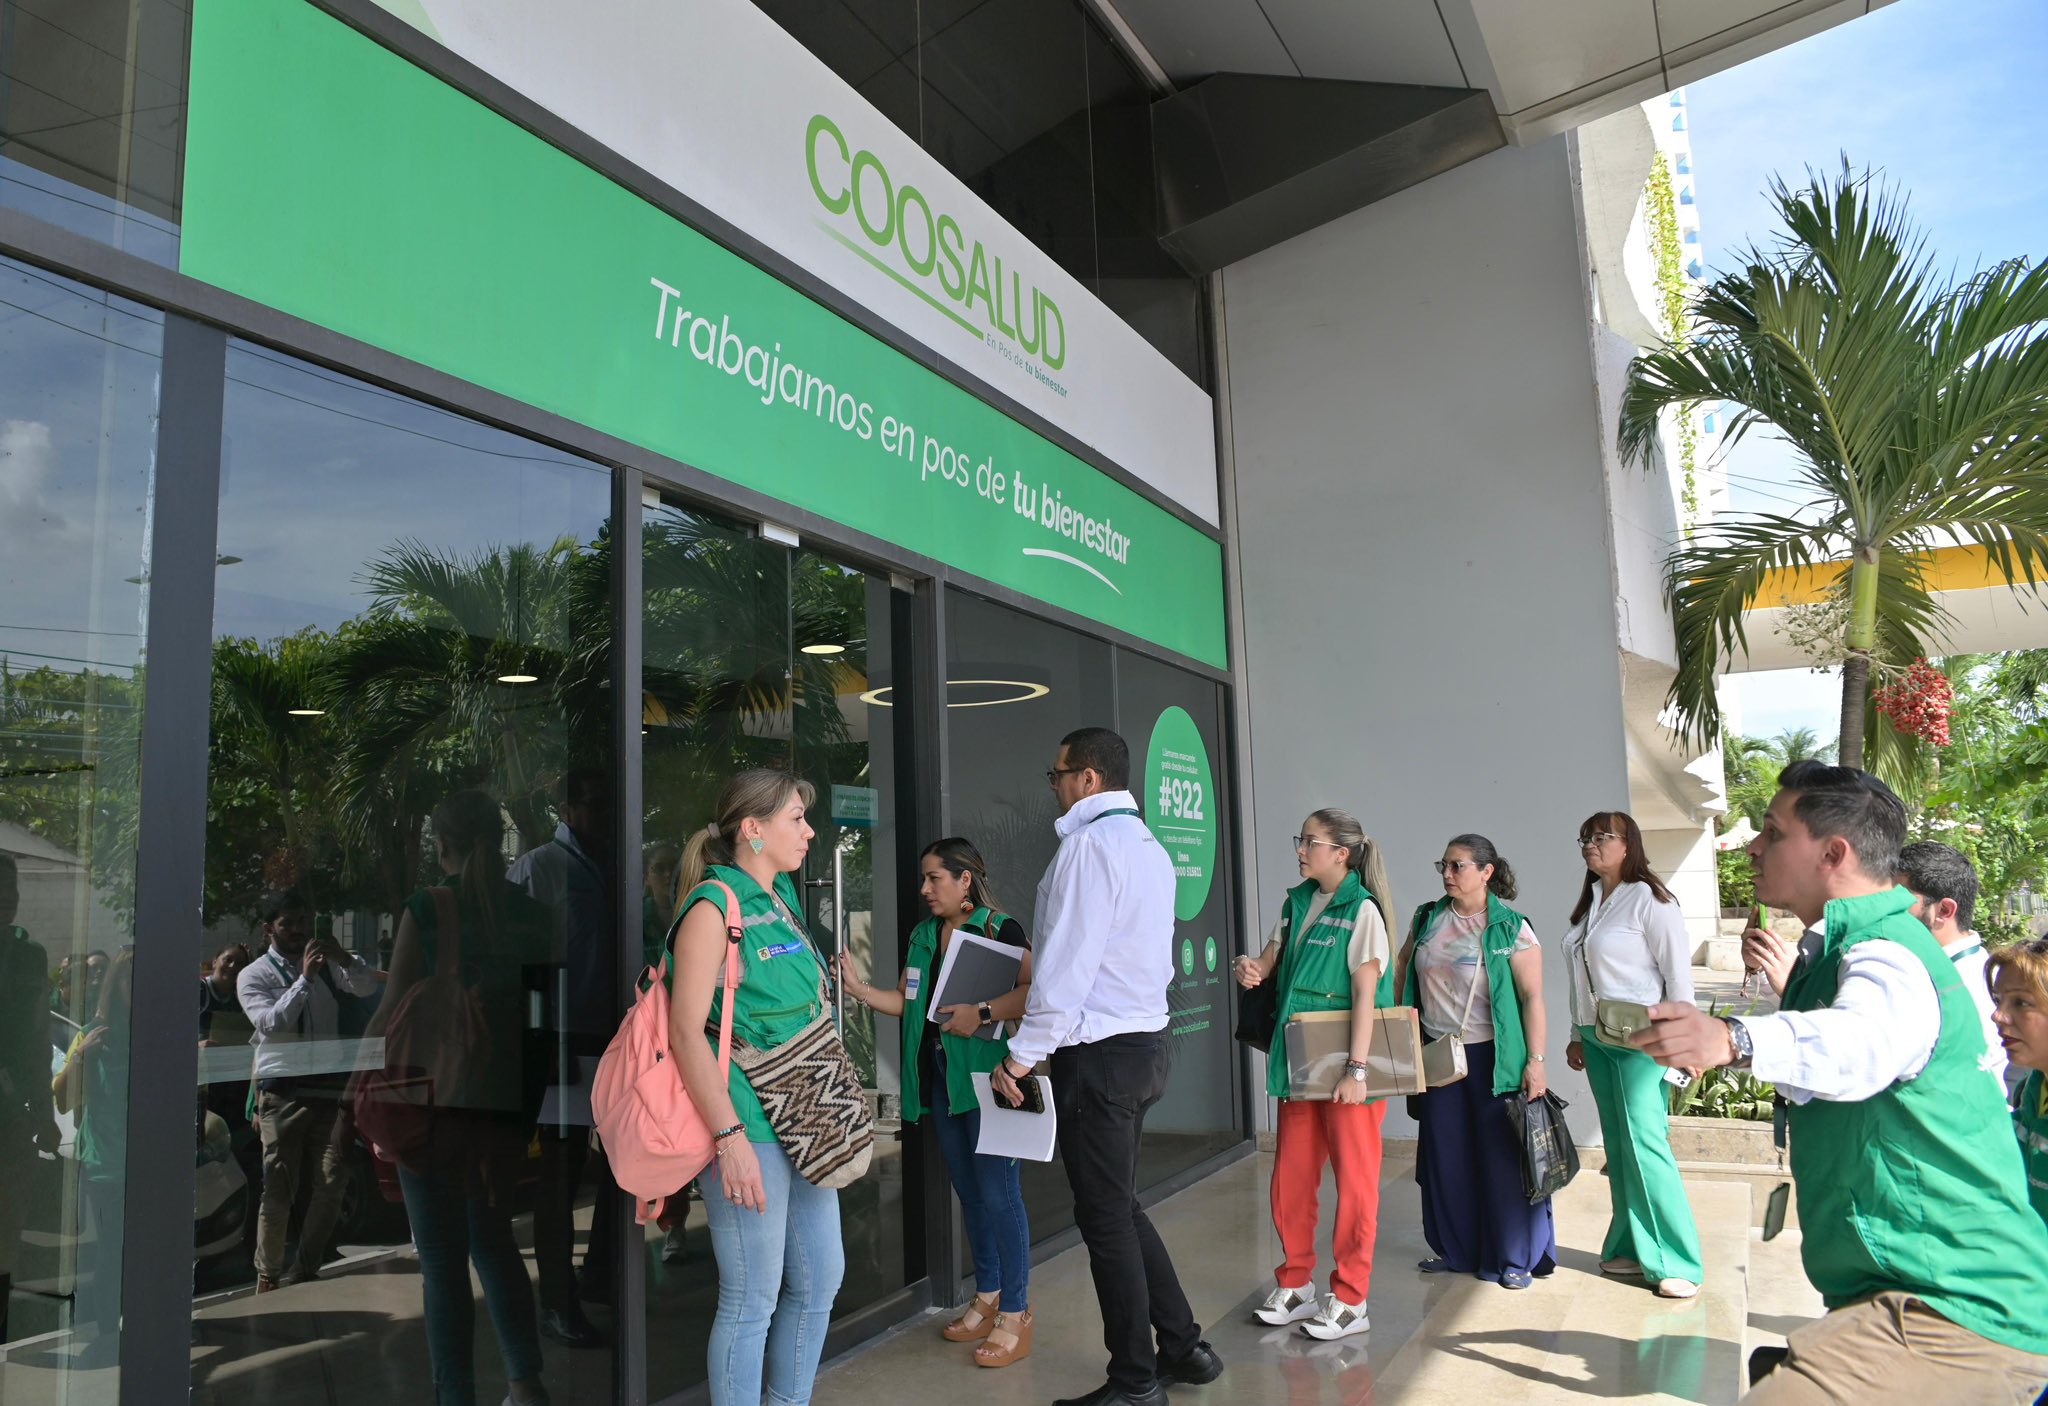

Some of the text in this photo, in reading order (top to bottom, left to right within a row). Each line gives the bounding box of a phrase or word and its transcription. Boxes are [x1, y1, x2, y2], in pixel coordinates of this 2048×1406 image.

[805, 113, 1065, 371] COOSALUD
[650, 277, 1131, 566] Trabajamos en pos de tu bienestar
[986, 333, 996, 350] En
[1014, 352, 1023, 368] de
[1025, 361, 1033, 375] tu
[1035, 367, 1068, 398] bienestar
[1159, 776, 1203, 819] #922
